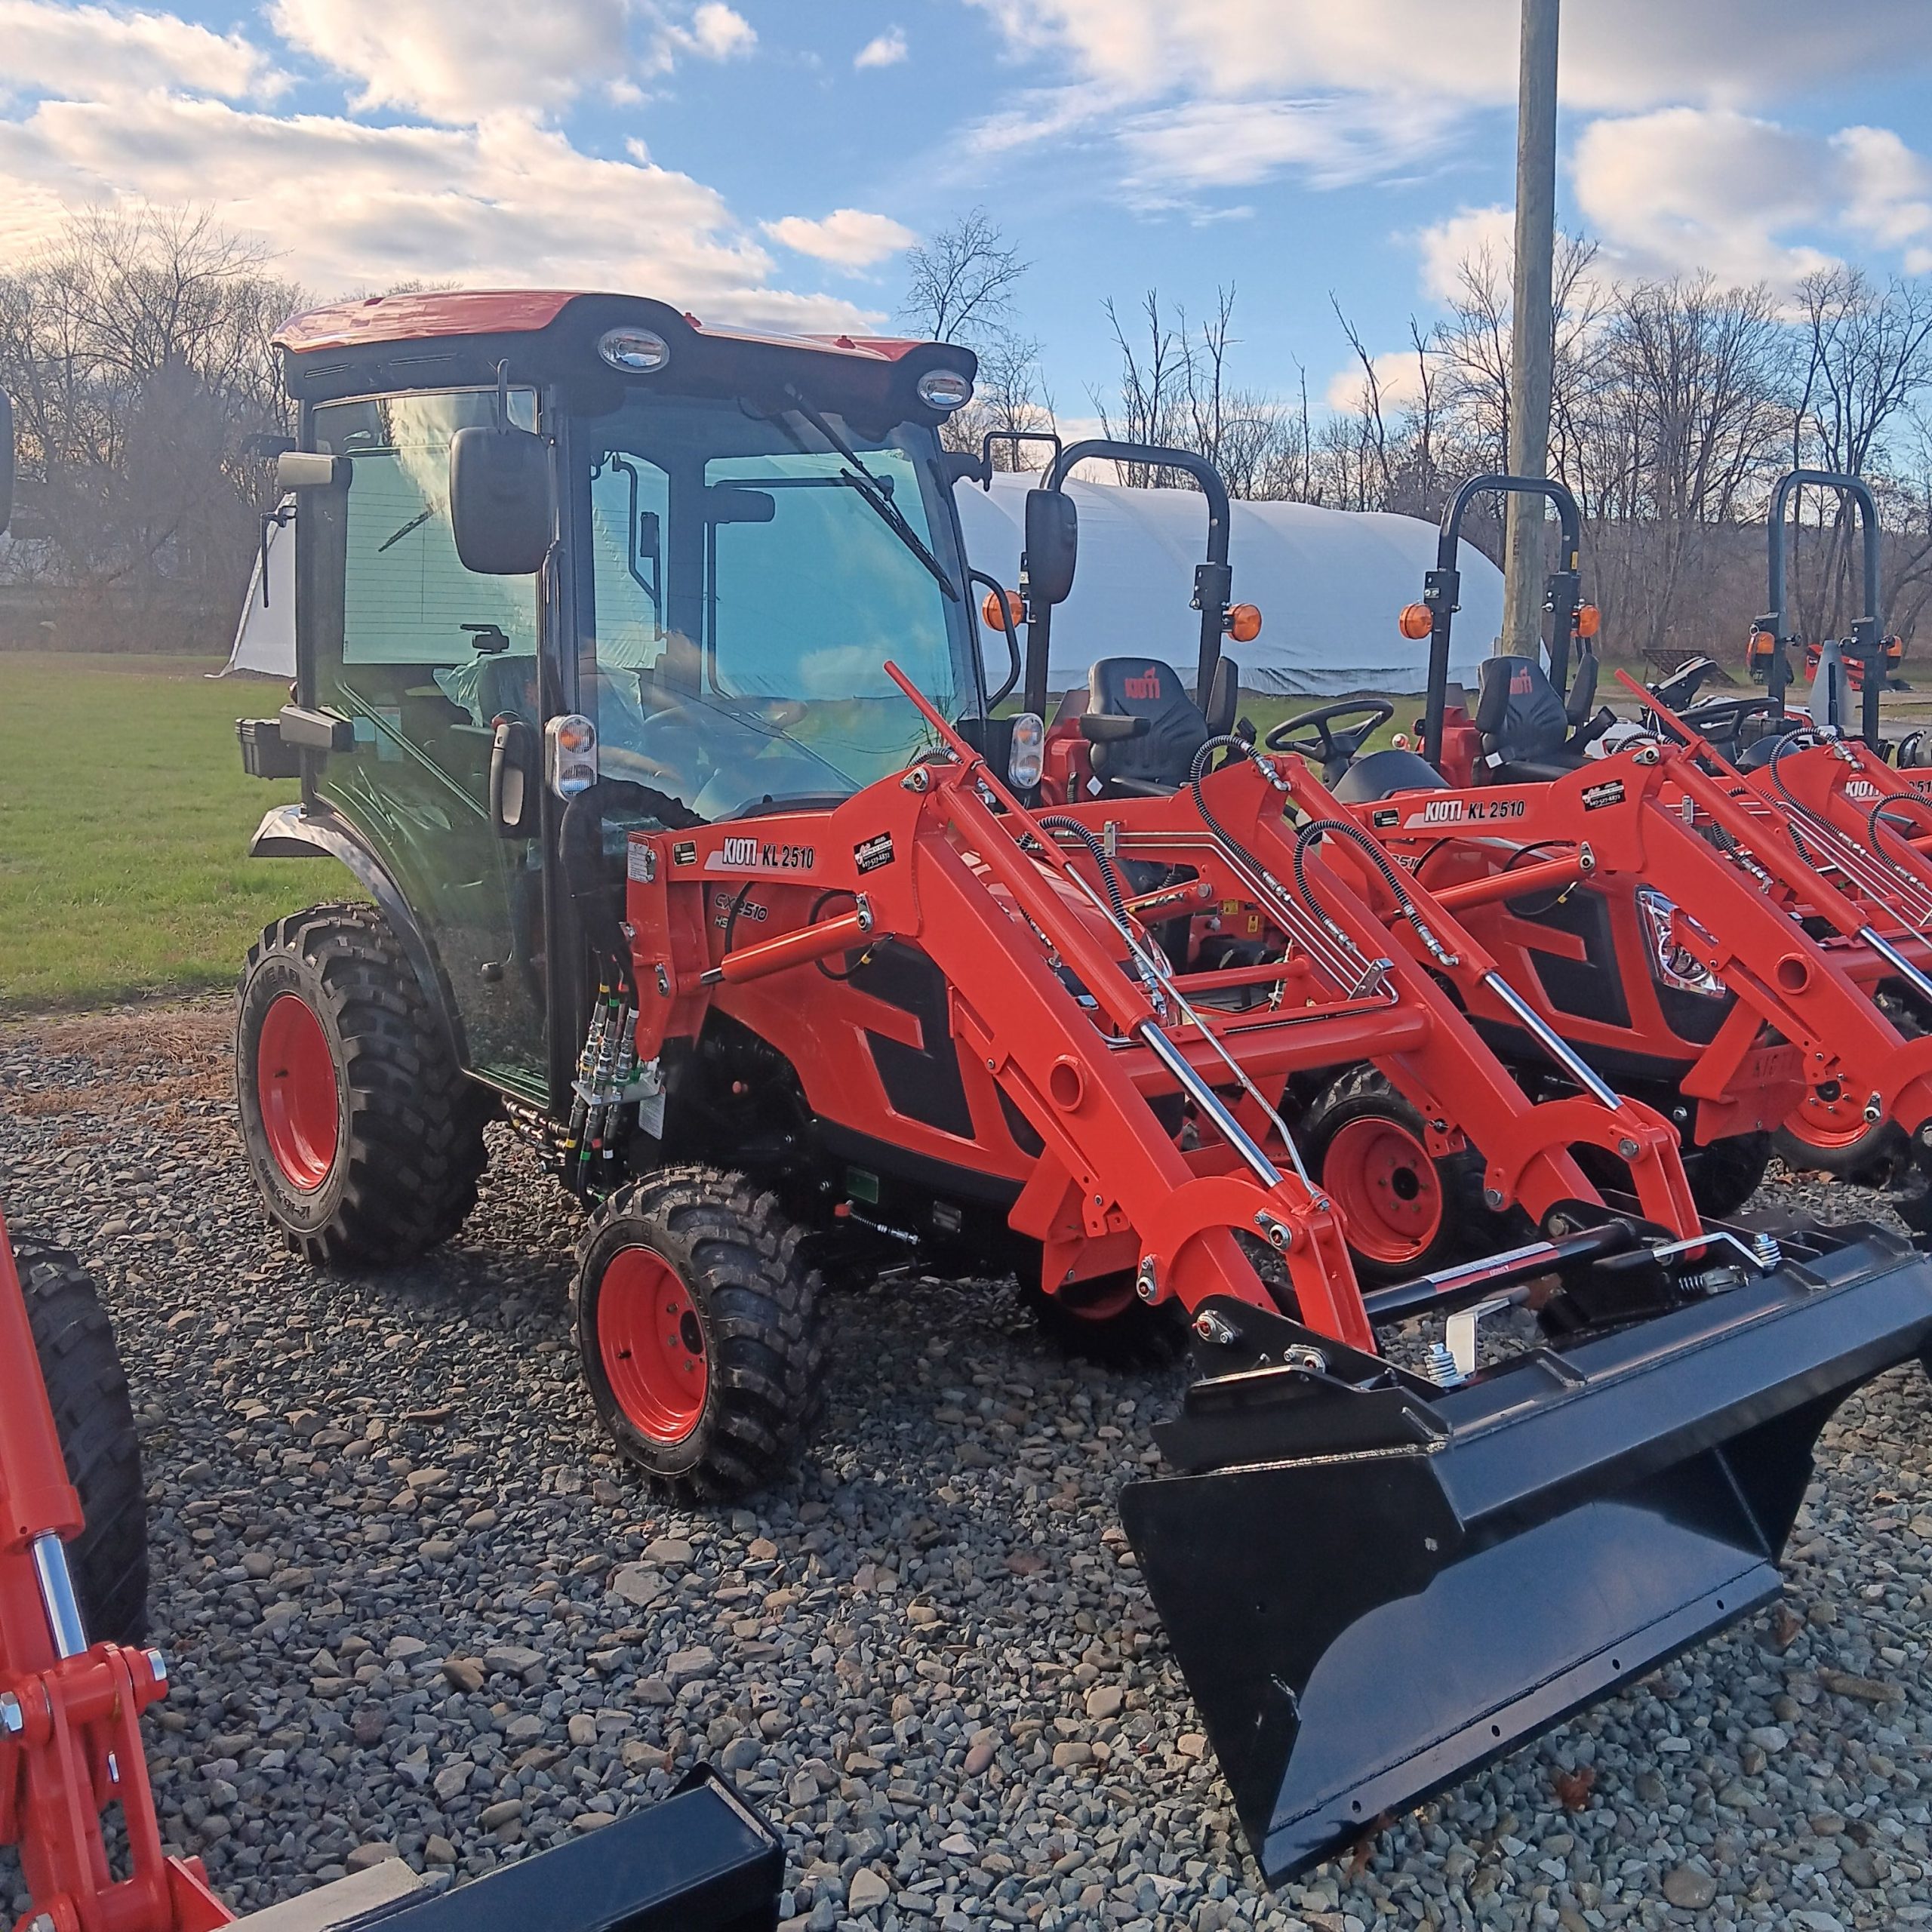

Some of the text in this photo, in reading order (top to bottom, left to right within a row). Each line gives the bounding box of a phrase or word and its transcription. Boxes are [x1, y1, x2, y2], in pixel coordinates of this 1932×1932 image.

[1424, 799, 1524, 823] KIOTI KL 2510
[722, 837, 758, 866] KIOTI
[761, 844, 779, 867] KL
[781, 844, 814, 869] 2510
